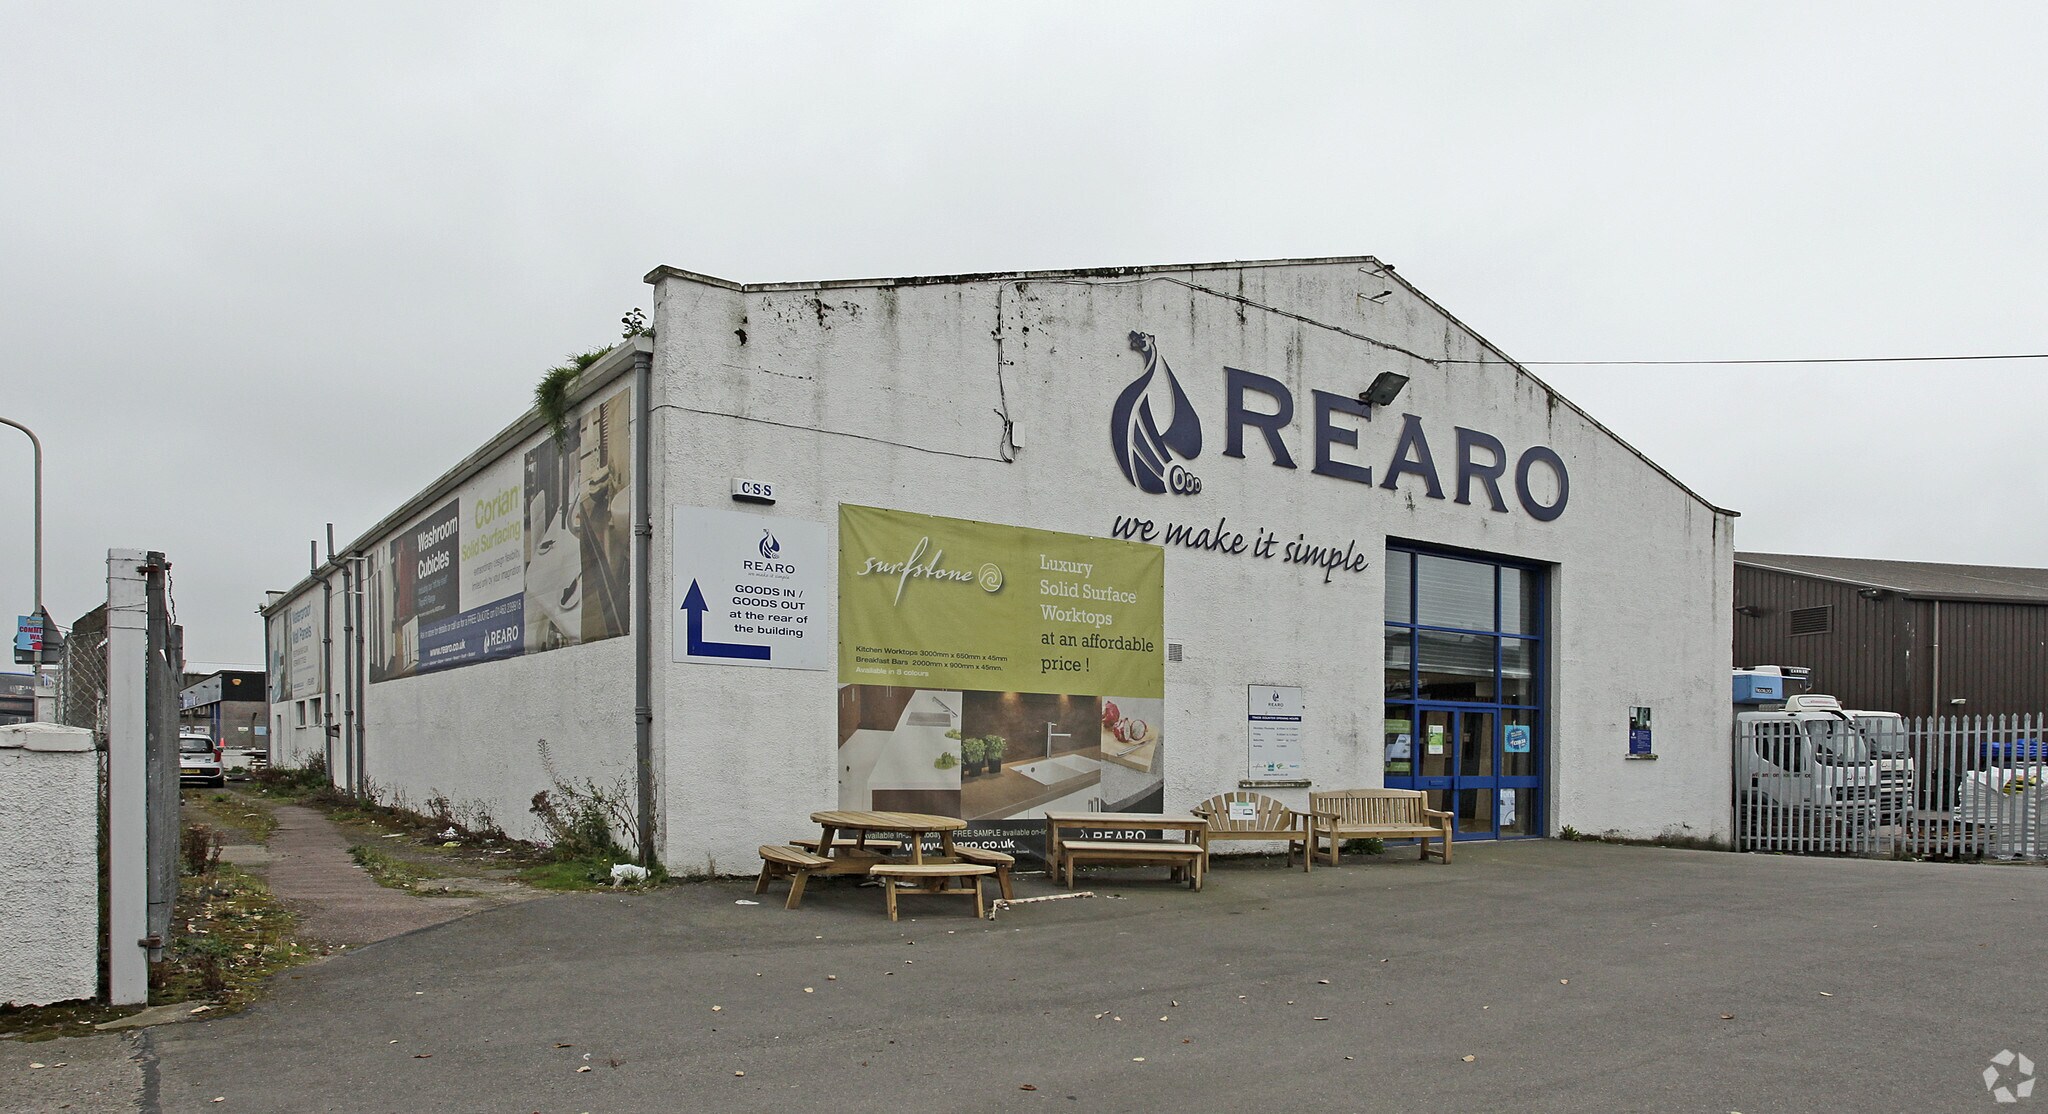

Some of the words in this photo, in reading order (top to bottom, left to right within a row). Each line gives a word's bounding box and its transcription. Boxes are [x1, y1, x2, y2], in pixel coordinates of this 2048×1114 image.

[1224, 366, 1569, 521] REARO
[475, 485, 519, 530] Corian
[417, 516, 458, 553] Washroom
[461, 538, 480, 561] Solid
[480, 520, 521, 552] Surfacing
[1112, 515, 1159, 541] we
[1165, 517, 1248, 555] make
[1254, 527, 1279, 558] it
[1284, 534, 1368, 583] simple
[418, 550, 450, 580] Cubicles
[743, 560, 796, 574] REARO
[857, 536, 973, 607] surfstone
[1040, 554, 1093, 578] Luxury
[735, 584, 780, 596] GOODS
[783, 589, 796, 597] IN
[798, 590, 804, 598] /
[1040, 579, 1079, 598] Solid
[1083, 583, 1137, 603] Surface
[732, 596, 778, 608] GOODS
[781, 600, 806, 610] OUT
[729, 611, 742, 619] at
[745, 611, 765, 621] the
[768, 614, 793, 622] rear
[796, 616, 809, 624] of
[1040, 604, 1113, 628] Worktops
[490, 624, 519, 646] REARO
[734, 624, 754, 634] the
[757, 626, 804, 639] building
[430, 638, 466, 656] www.rearo.co.uk
[1041, 632, 1055, 645] at
[1059, 634, 1077, 647] an
[1081, 633, 1154, 652] affordable
[855, 645, 883, 653] Kitchen
[884, 647, 918, 656] Worktops
[920, 649, 949, 658] 3000mm
[956, 652, 981, 660] 650mm
[855, 656, 890, 664] Breakfast
[891, 658, 908, 666] Bars
[912, 659, 943, 667] 2000mm
[855, 666, 887, 675] Available
[903, 669, 929, 677] colours
[1041, 655, 1081, 674] price
[1085, 657, 1090, 672] !
[952, 829, 972, 838] FREE
[973, 828, 1001, 837] SAMPLE
[1002, 828, 1030, 837] available
[1093, 830, 1146, 840] REARO
